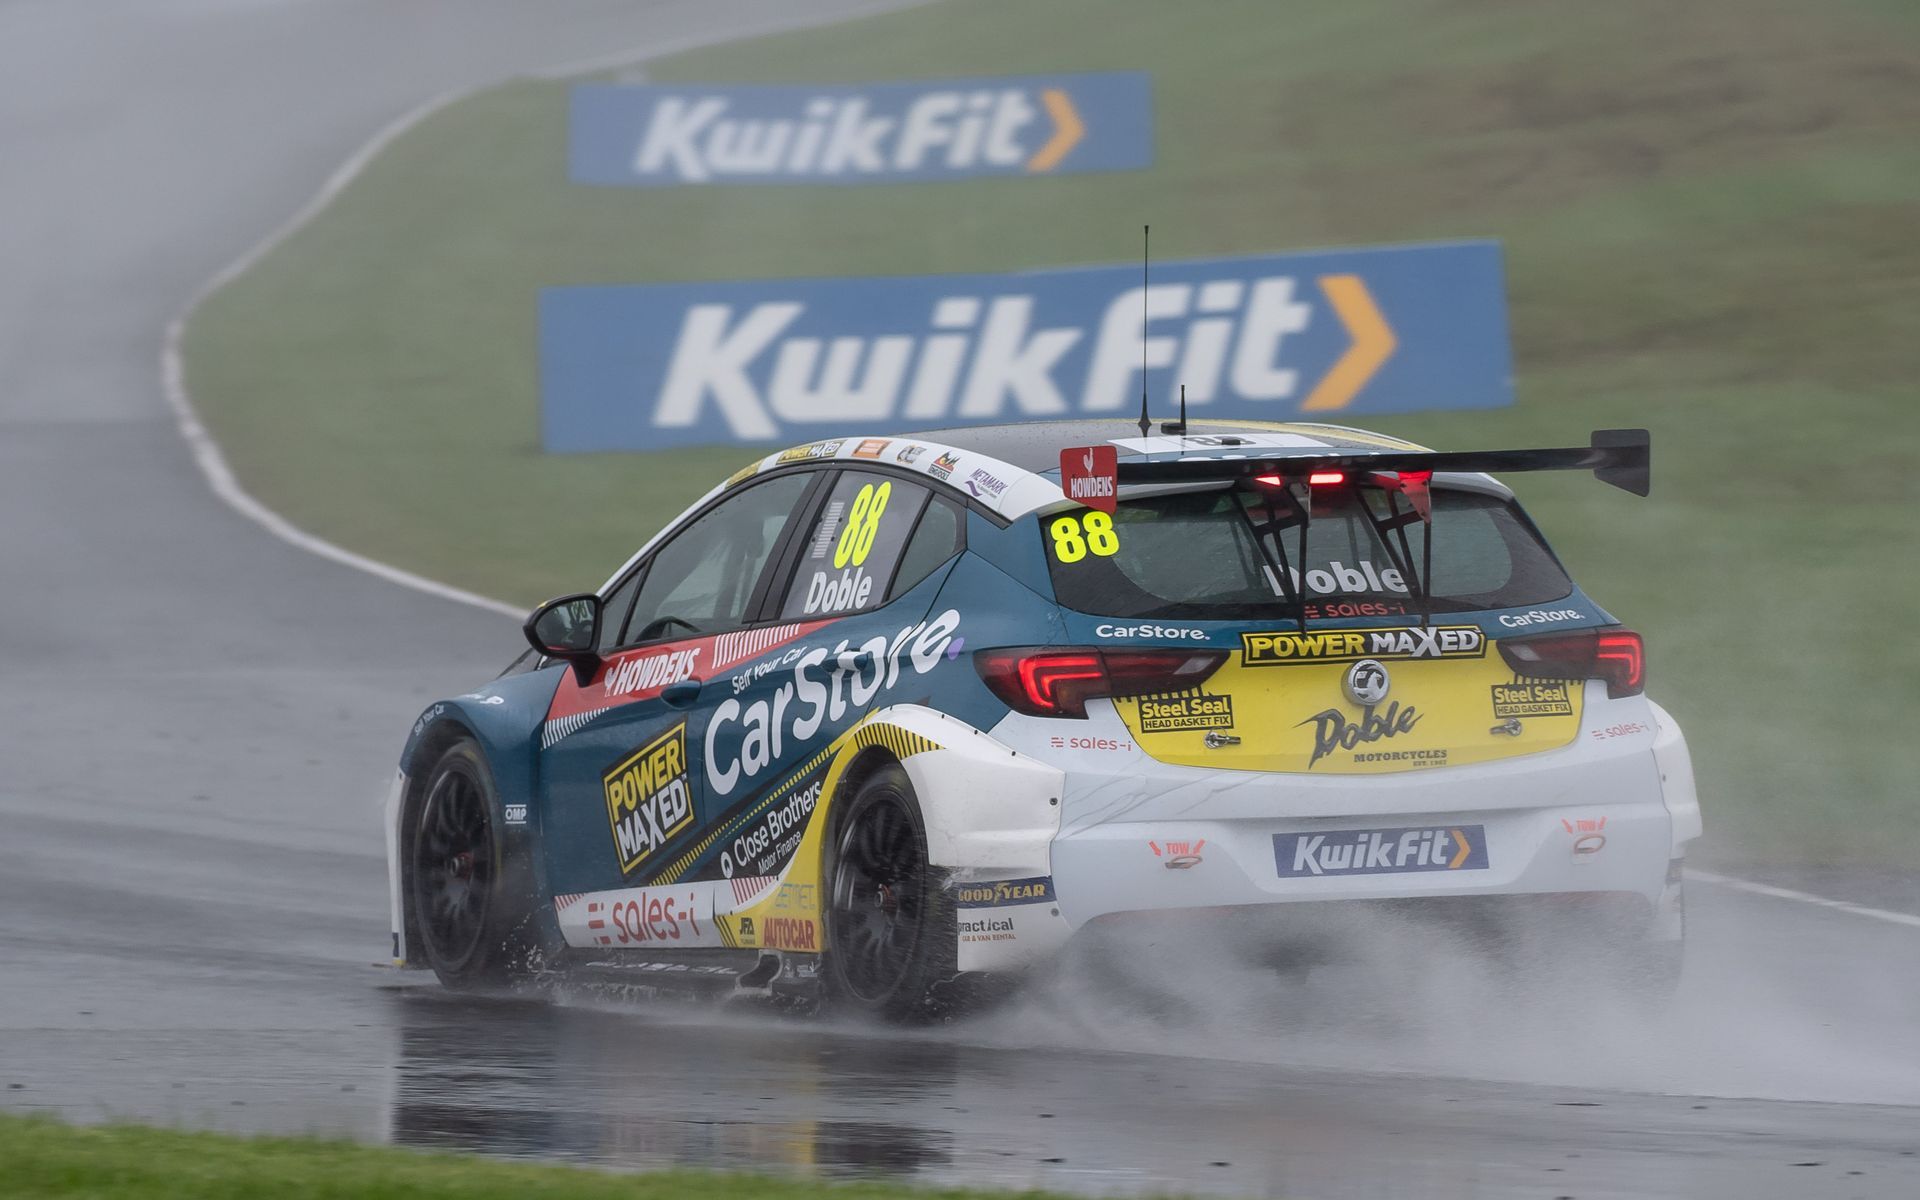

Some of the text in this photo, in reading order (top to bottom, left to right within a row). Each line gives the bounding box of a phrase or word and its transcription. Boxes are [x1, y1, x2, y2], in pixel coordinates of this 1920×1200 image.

[969, 468, 1009, 494] METAMARK
[1070, 476, 1114, 498] HOWDENS
[834, 481, 892, 569] 88
[1050, 511, 1120, 563] 88
[803, 567, 873, 614] Doble
[1250, 627, 1480, 658] POWER MAXED
[613, 648, 701, 695] HOWDENS
[732, 667, 752, 695] Sell
[754, 657, 782, 680] Your
[1141, 697, 1231, 719] Steel Seal
[1494, 685, 1567, 704] Steel Seal
[1497, 702, 1569, 714] HEAD GASKET FIX
[1145, 715, 1231, 729] HEAD GASKET FIX
[1292, 701, 1425, 770] Doble
[1354, 750, 1448, 763] MOTORCYCLES
[609, 739, 681, 823] POWER
[505, 808, 527, 820] OMP
[616, 778, 687, 862] MAXED
[734, 781, 822, 867] Close Brothers
[758, 831, 802, 875] Motor Finance
[1166, 842, 1190, 855] TOW
[763, 918, 815, 949] AUTOCAR
